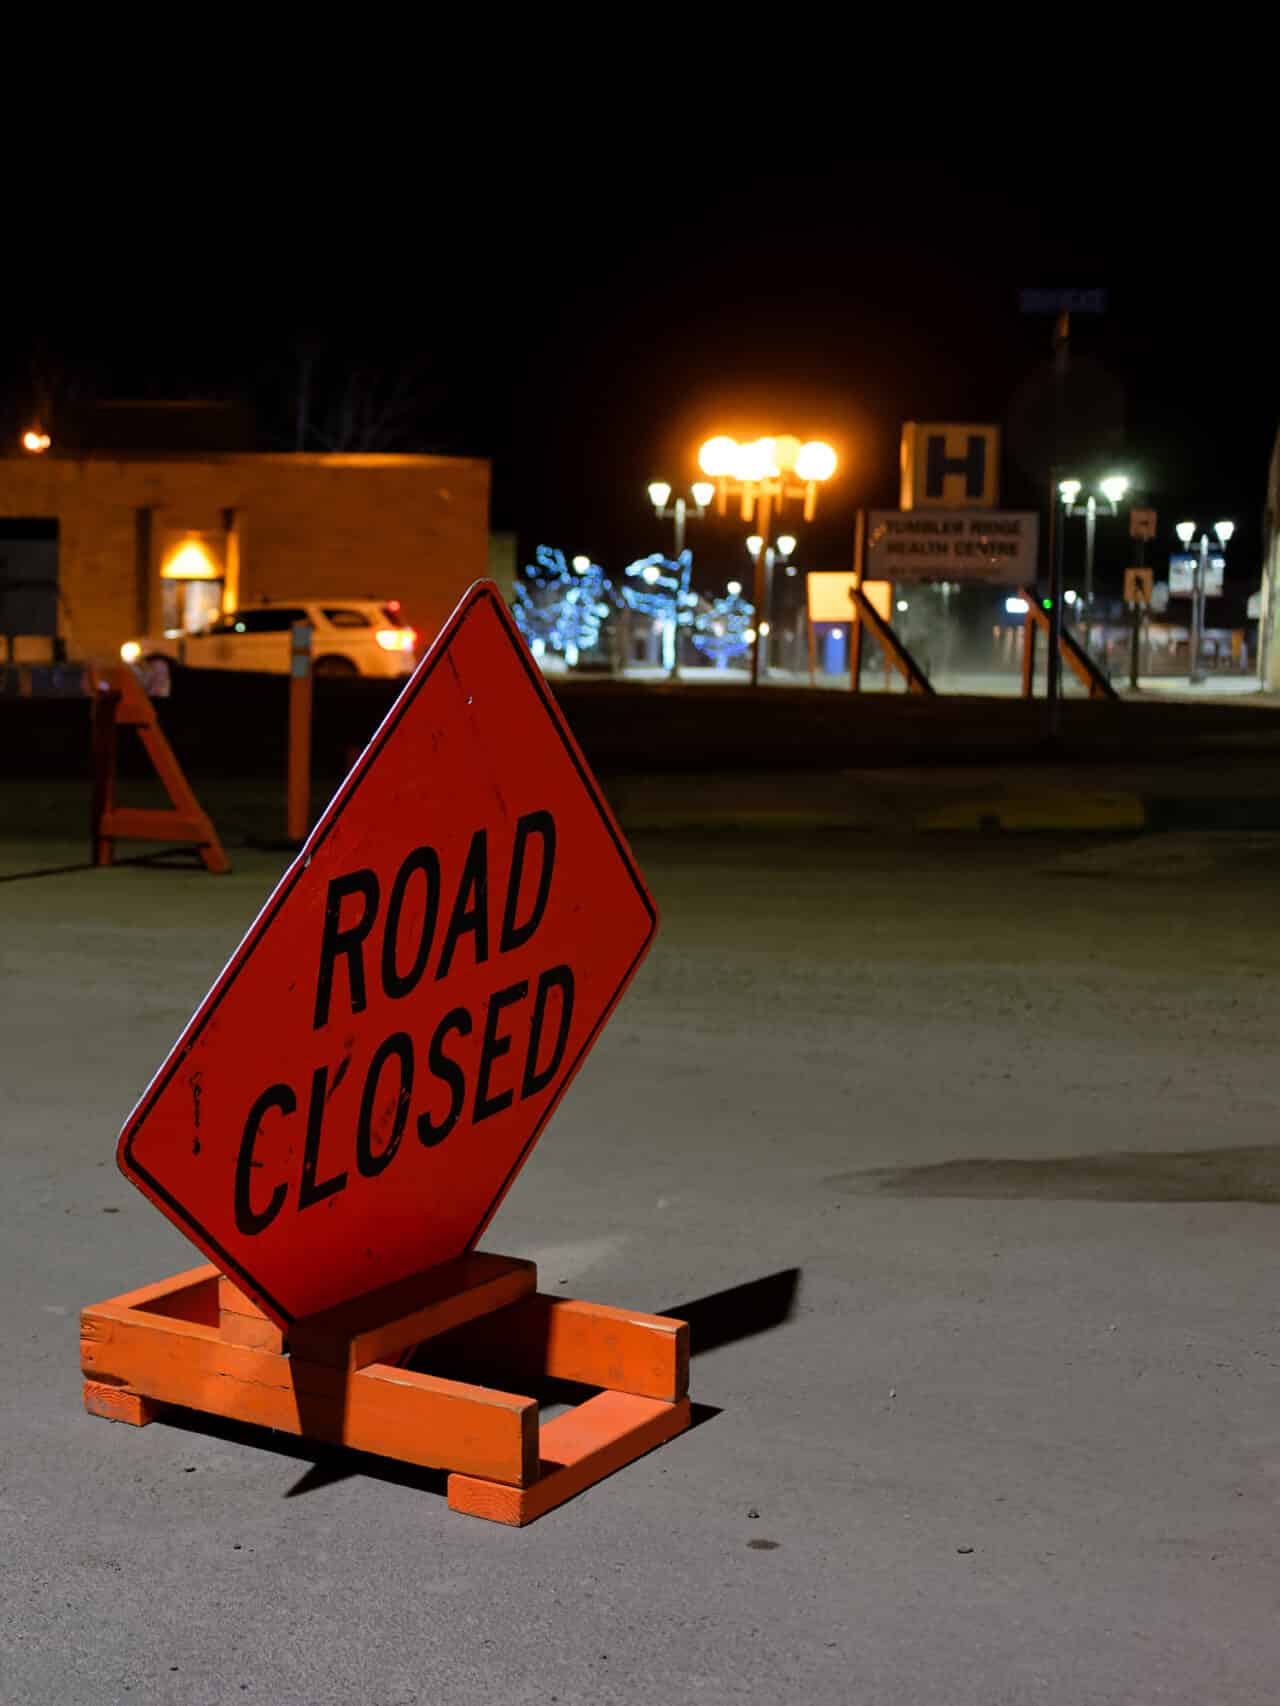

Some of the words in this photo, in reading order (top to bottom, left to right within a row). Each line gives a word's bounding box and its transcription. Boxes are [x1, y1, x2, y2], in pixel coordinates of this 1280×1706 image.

[927, 436, 985, 497] H
[314, 810, 556, 1030] ROAD
[234, 965, 575, 1234] CLOSED
